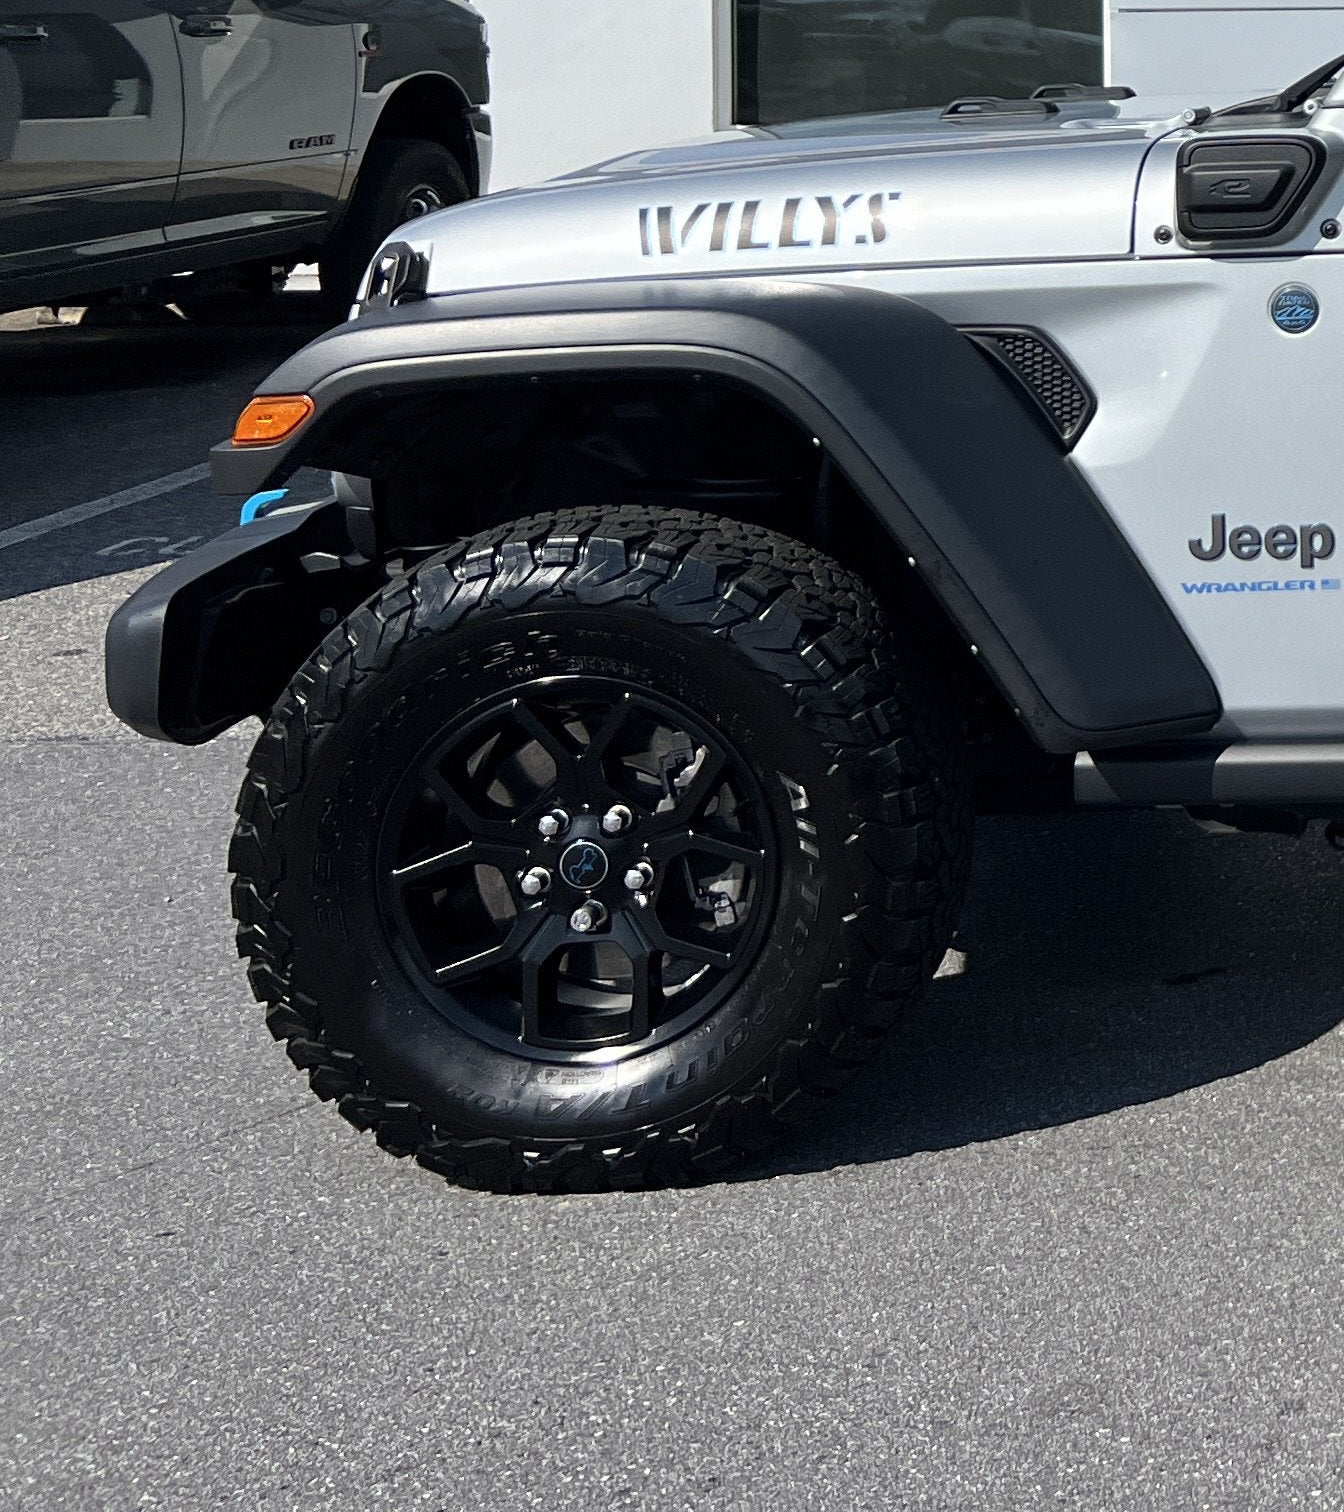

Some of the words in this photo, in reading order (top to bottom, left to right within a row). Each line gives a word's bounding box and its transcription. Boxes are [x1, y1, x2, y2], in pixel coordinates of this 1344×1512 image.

[638, 192, 901, 256] WILLYS
[1188, 512, 1336, 569] Jeep
[1181, 579, 1317, 595] WRANGLER
